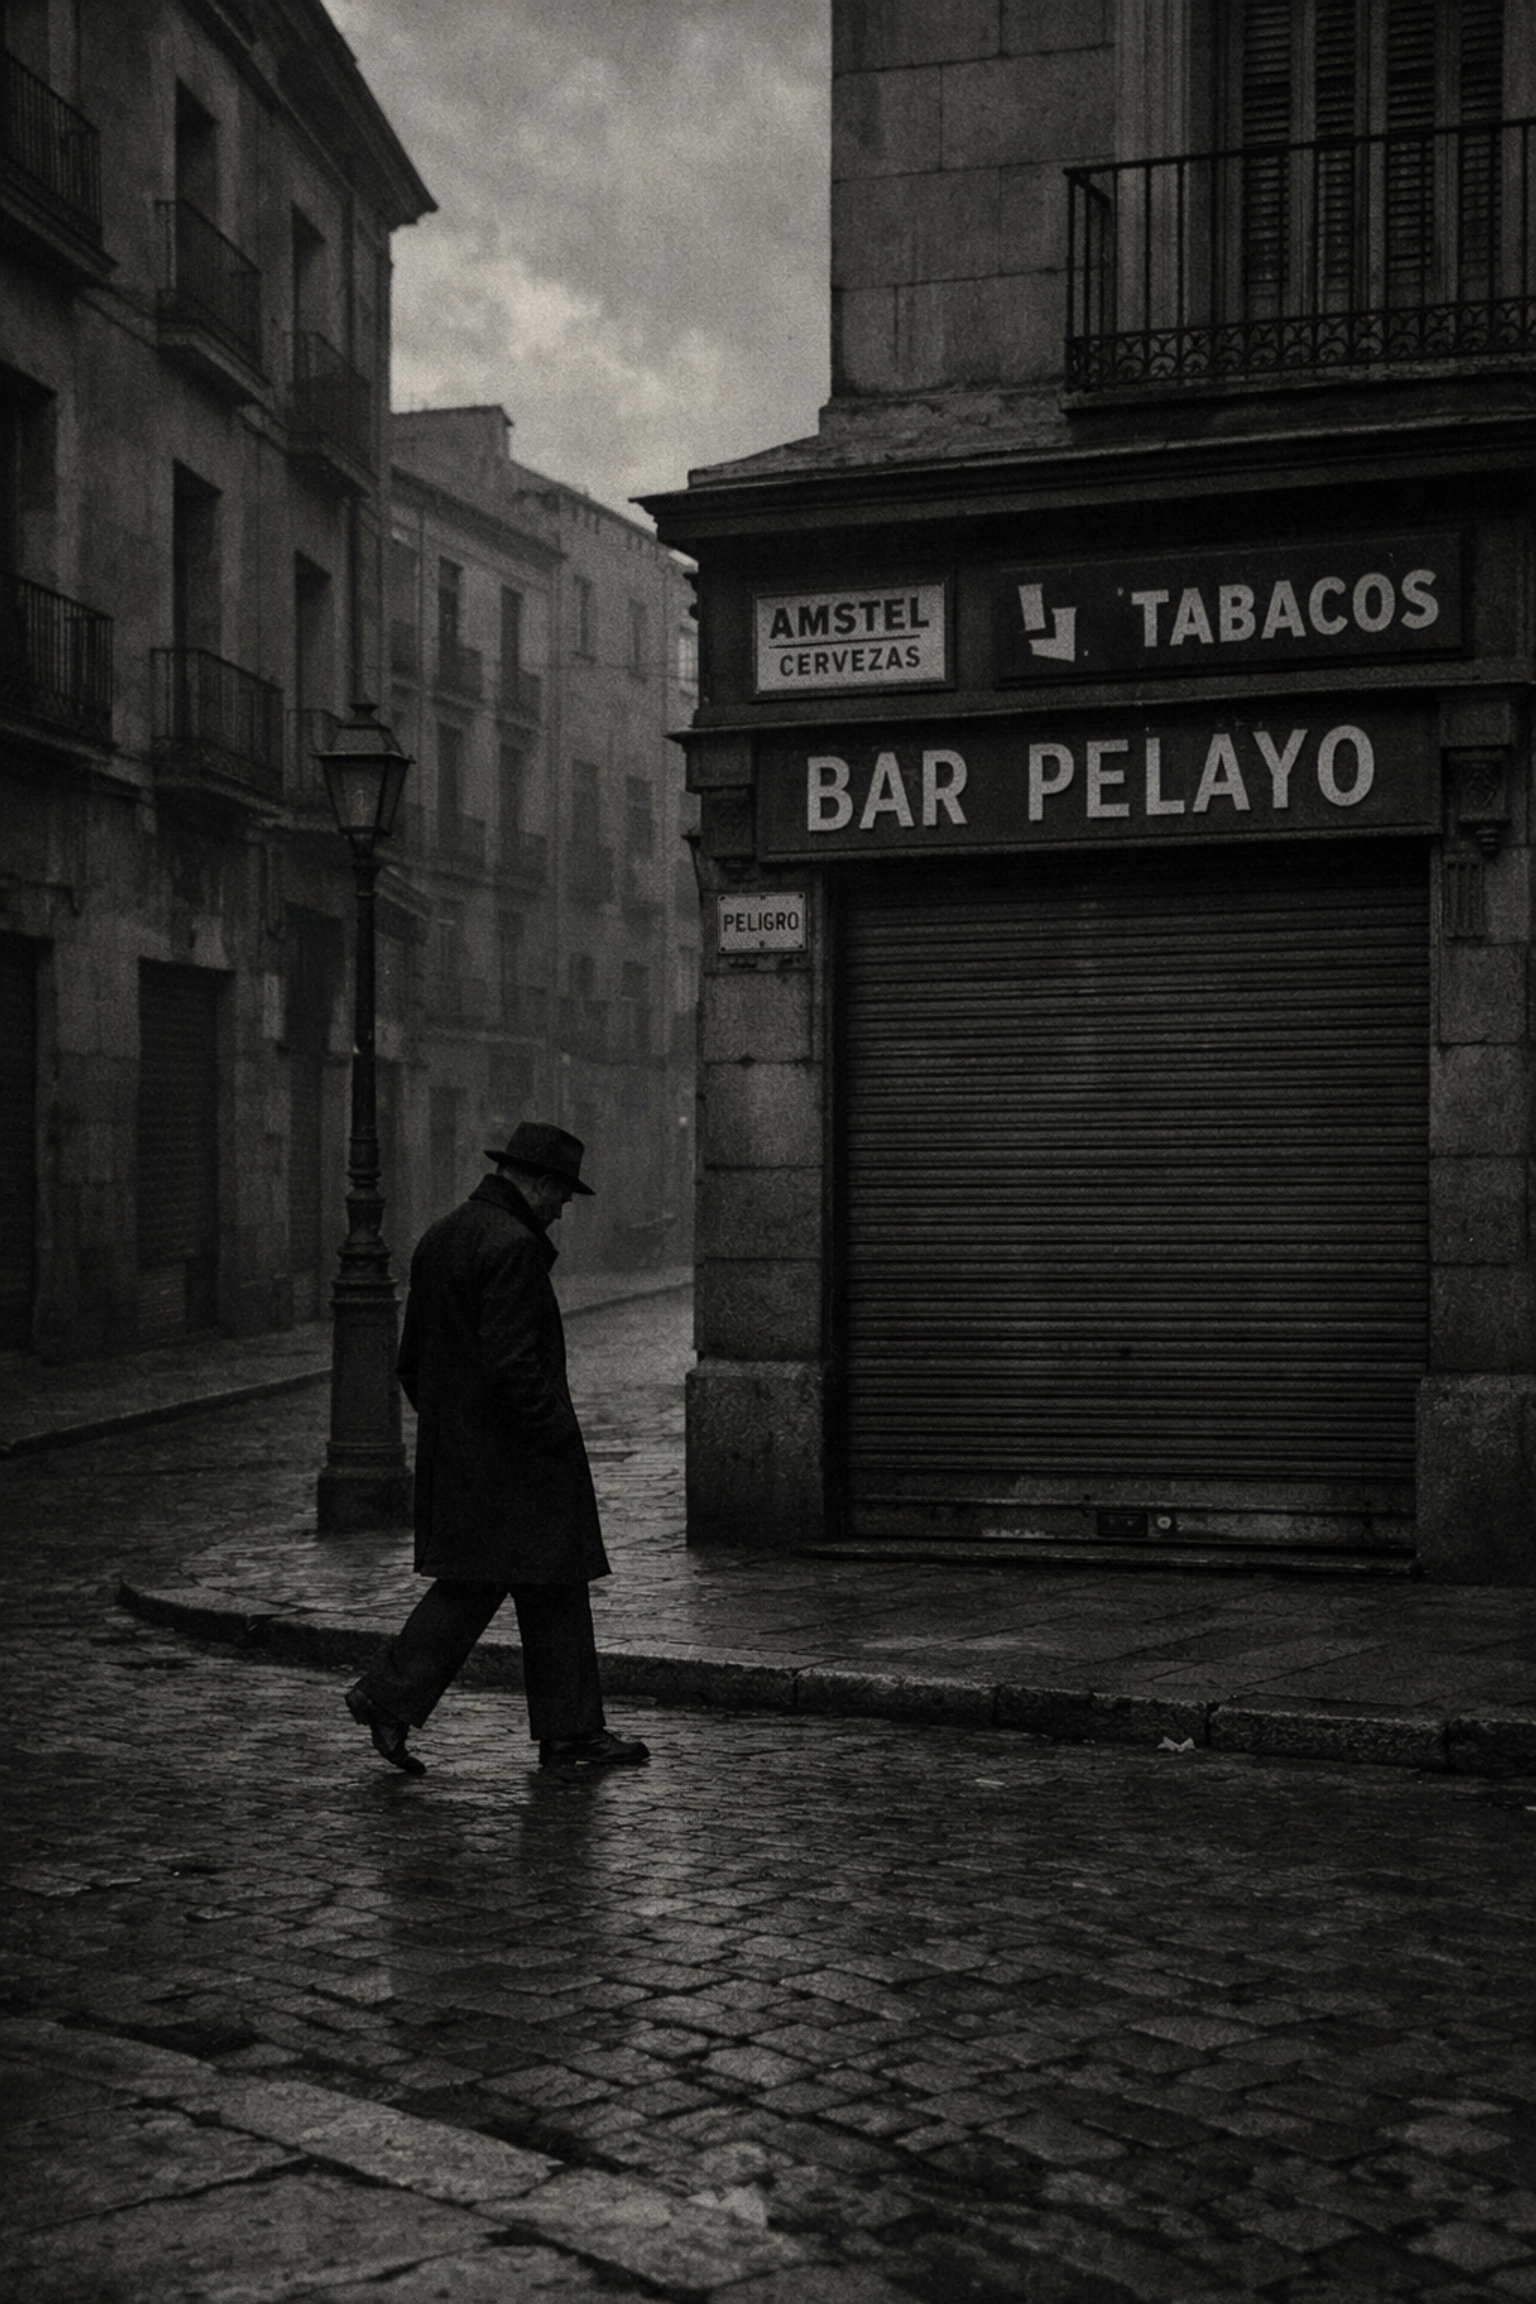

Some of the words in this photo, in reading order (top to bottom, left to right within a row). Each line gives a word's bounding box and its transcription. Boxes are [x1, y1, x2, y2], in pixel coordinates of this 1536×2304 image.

[769, 597, 930, 639] AMSTEL
[1131, 569, 1440, 649] TABACOS
[779, 646, 921, 676] CERVEZAS
[806, 749, 968, 831] BAR
[1027, 725, 1375, 821] PELAYO
[723, 911, 800, 932] PELIGRO
